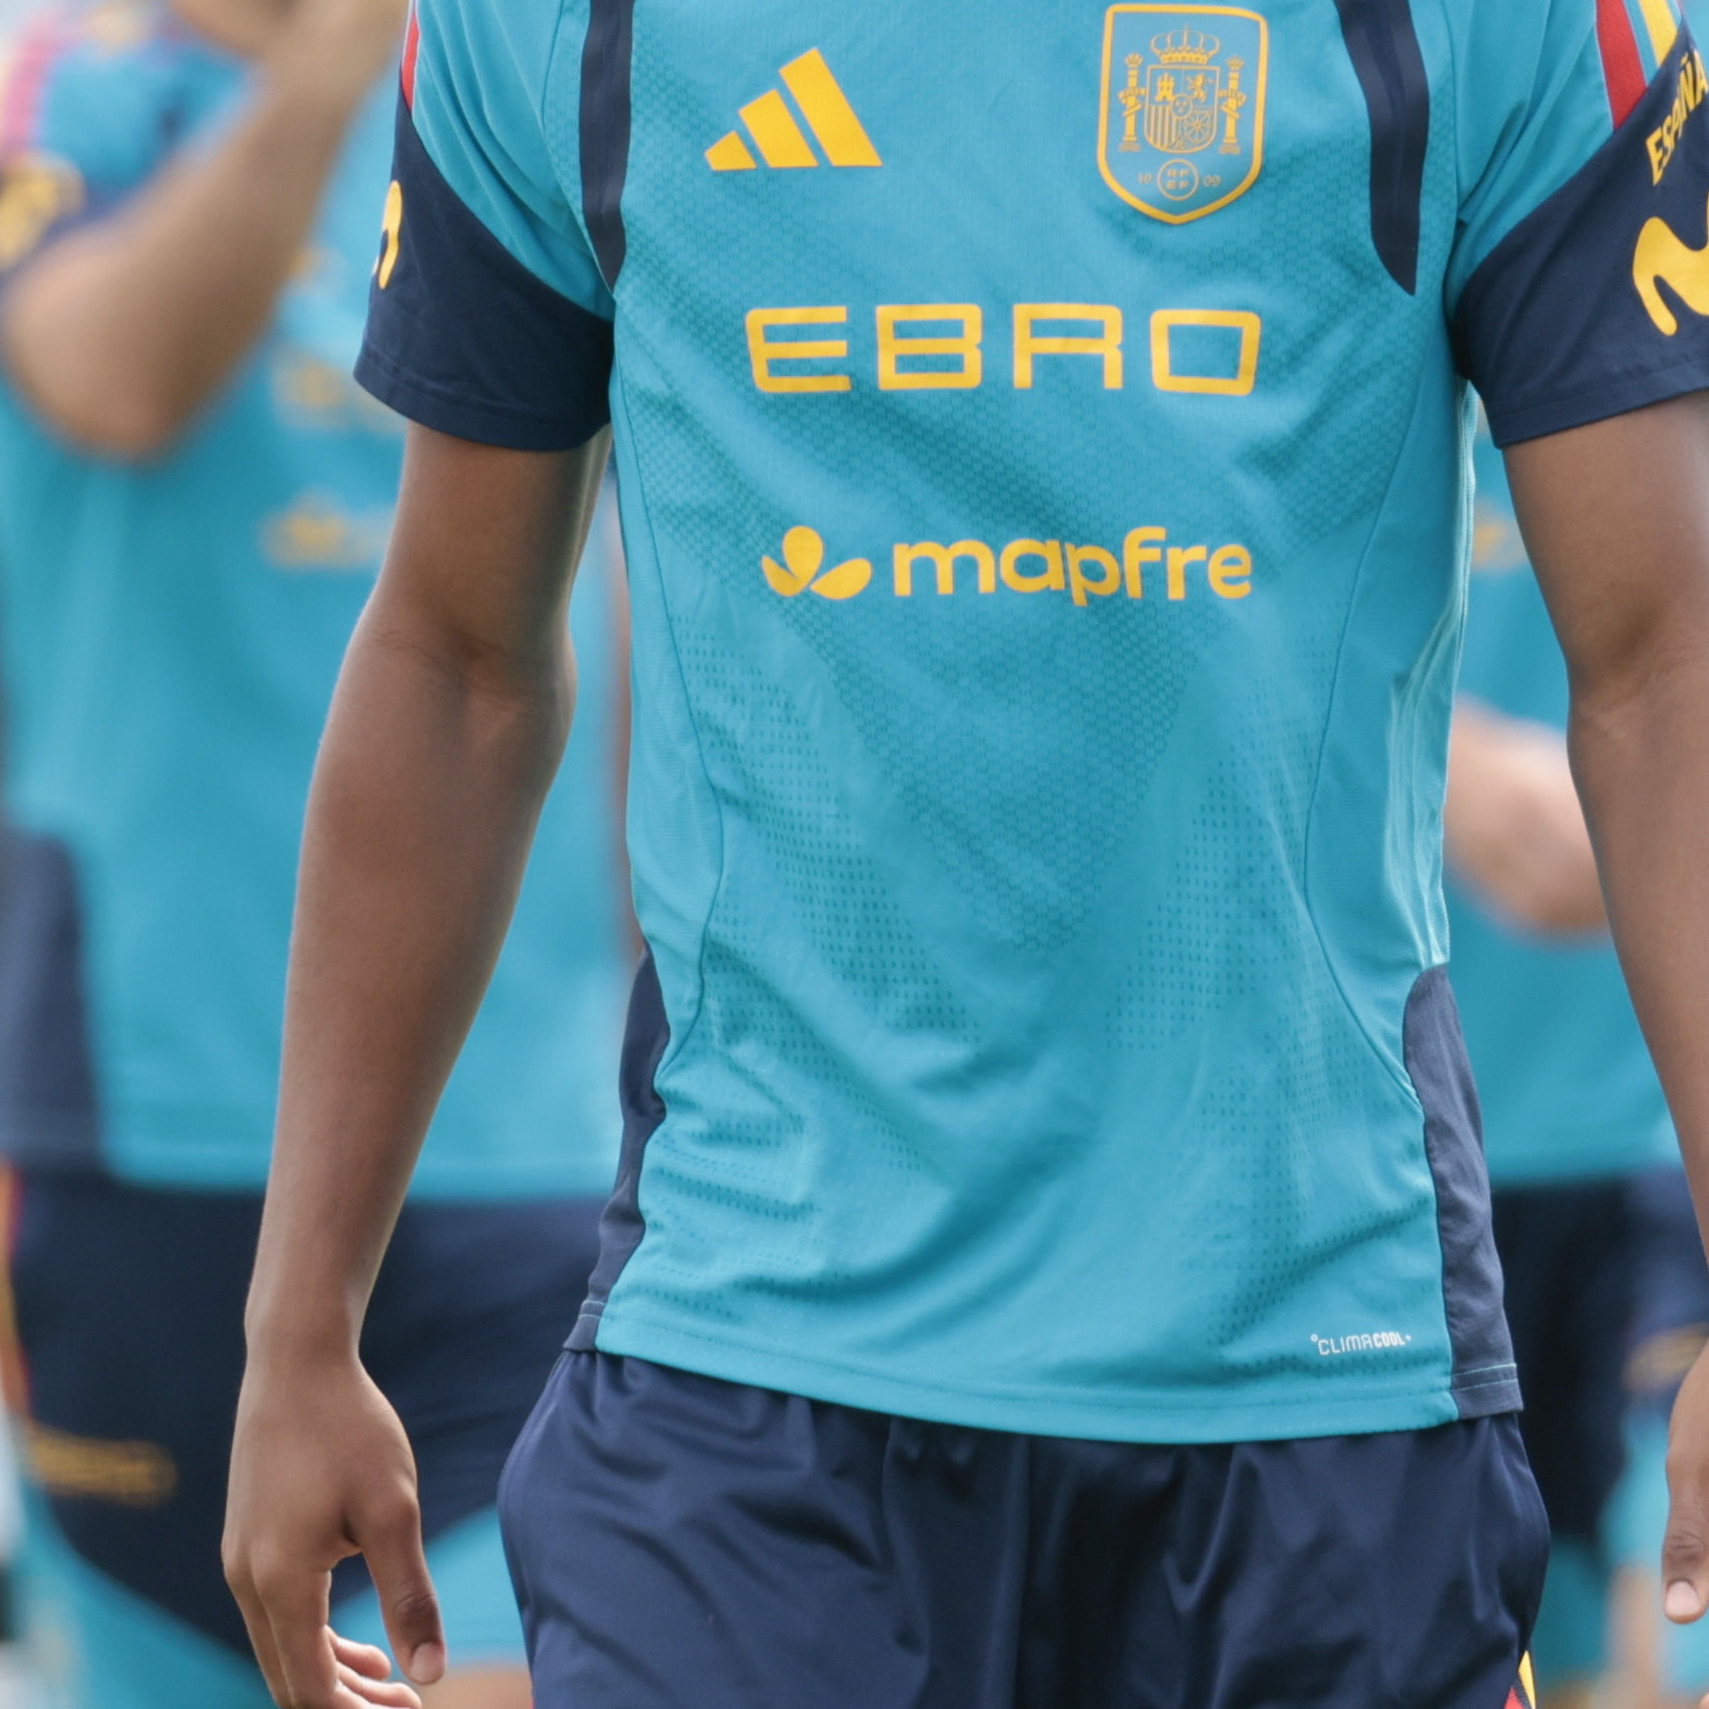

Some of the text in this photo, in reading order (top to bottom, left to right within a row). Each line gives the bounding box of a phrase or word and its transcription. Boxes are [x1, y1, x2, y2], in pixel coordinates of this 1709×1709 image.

[1645, 49, 1709, 187] ESPAÑA
[745, 303, 1261, 396] EBRO
[893, 526, 1252, 607] mapfre
